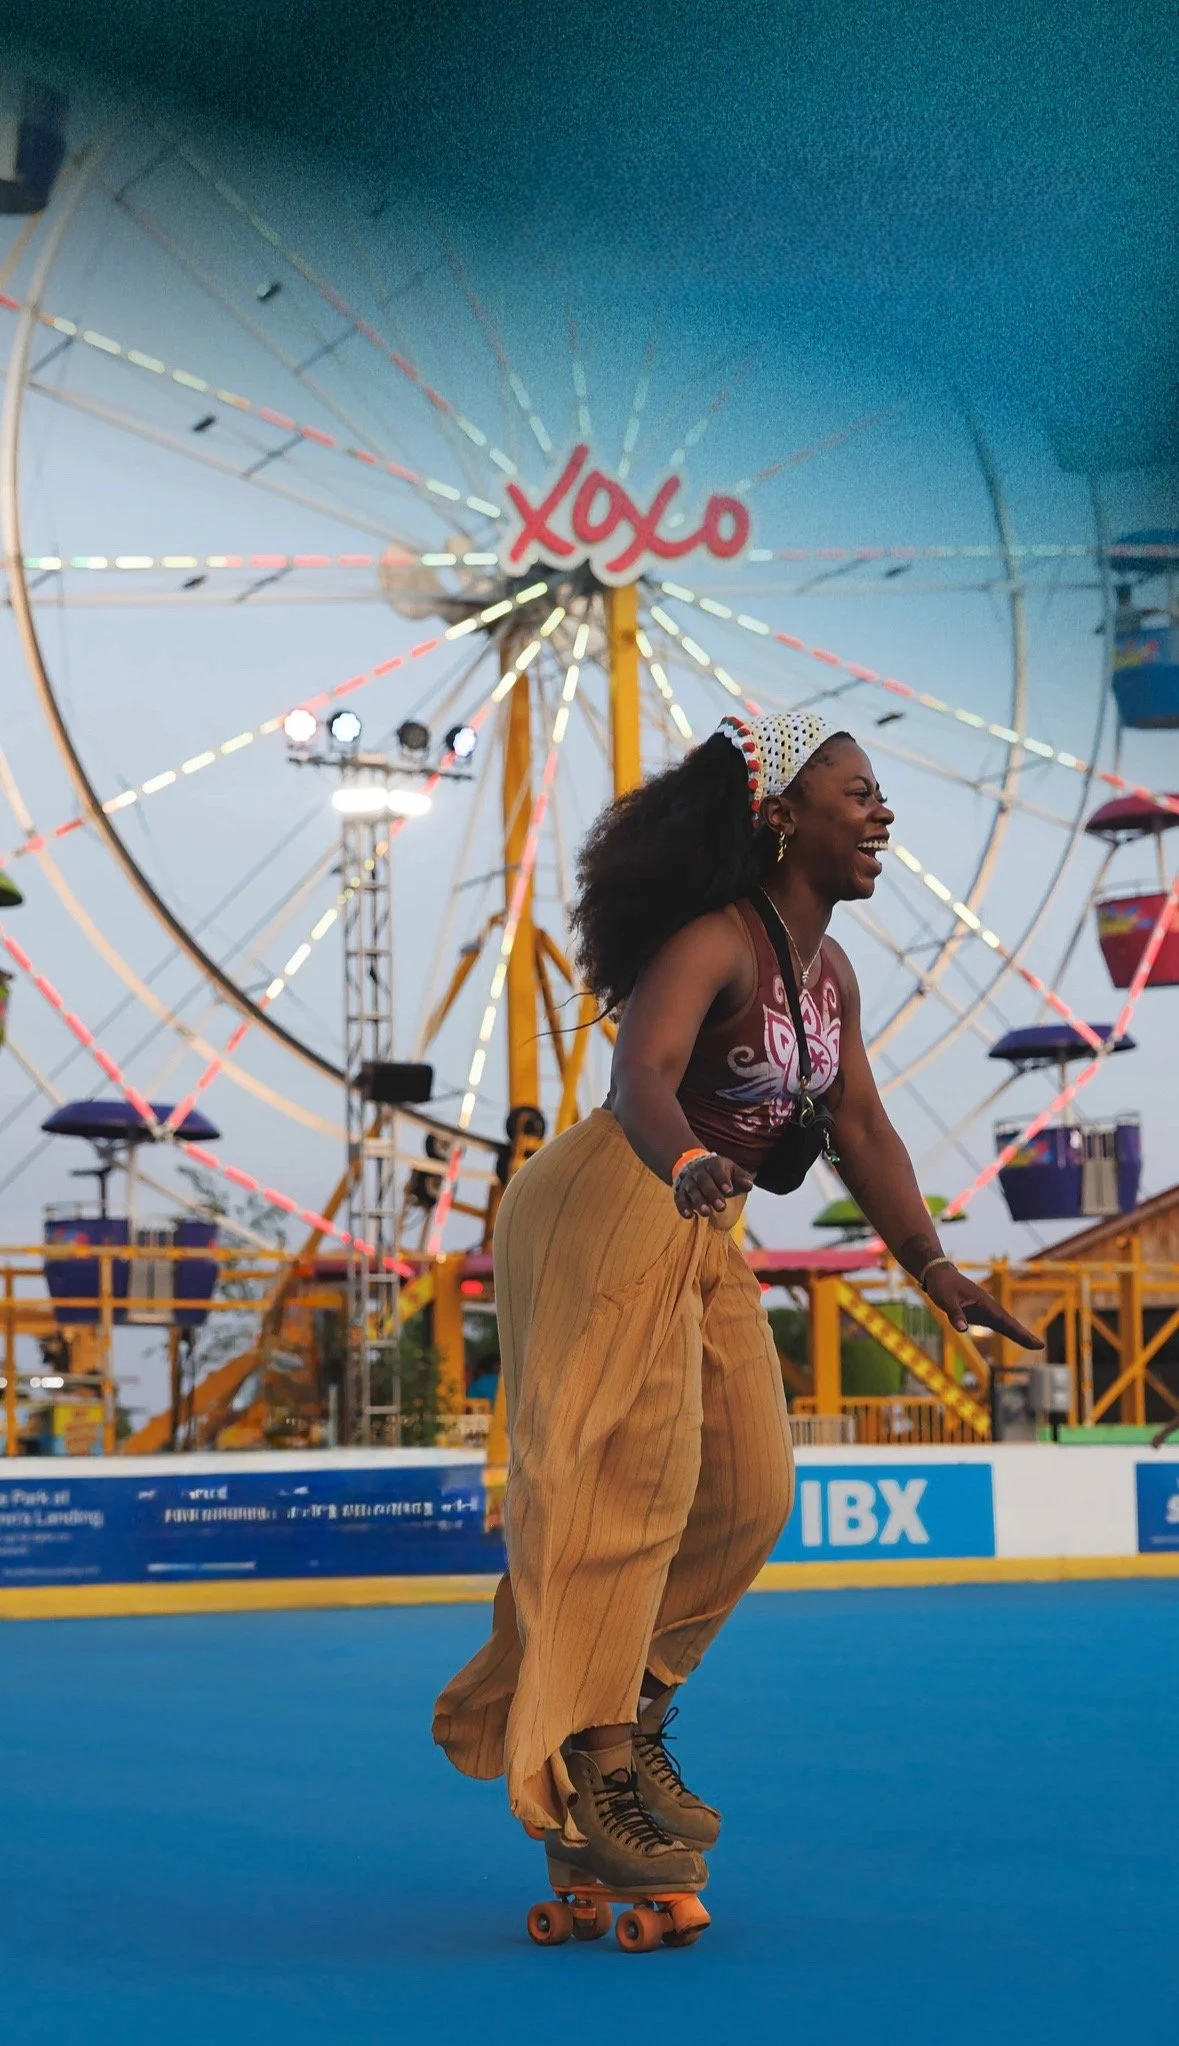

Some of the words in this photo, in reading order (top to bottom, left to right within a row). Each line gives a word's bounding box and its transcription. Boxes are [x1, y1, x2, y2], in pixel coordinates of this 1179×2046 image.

[11, 1489, 49, 1507] Park
[35, 1509, 105, 1530] Landing
[800, 1479, 930, 1547] IBX
